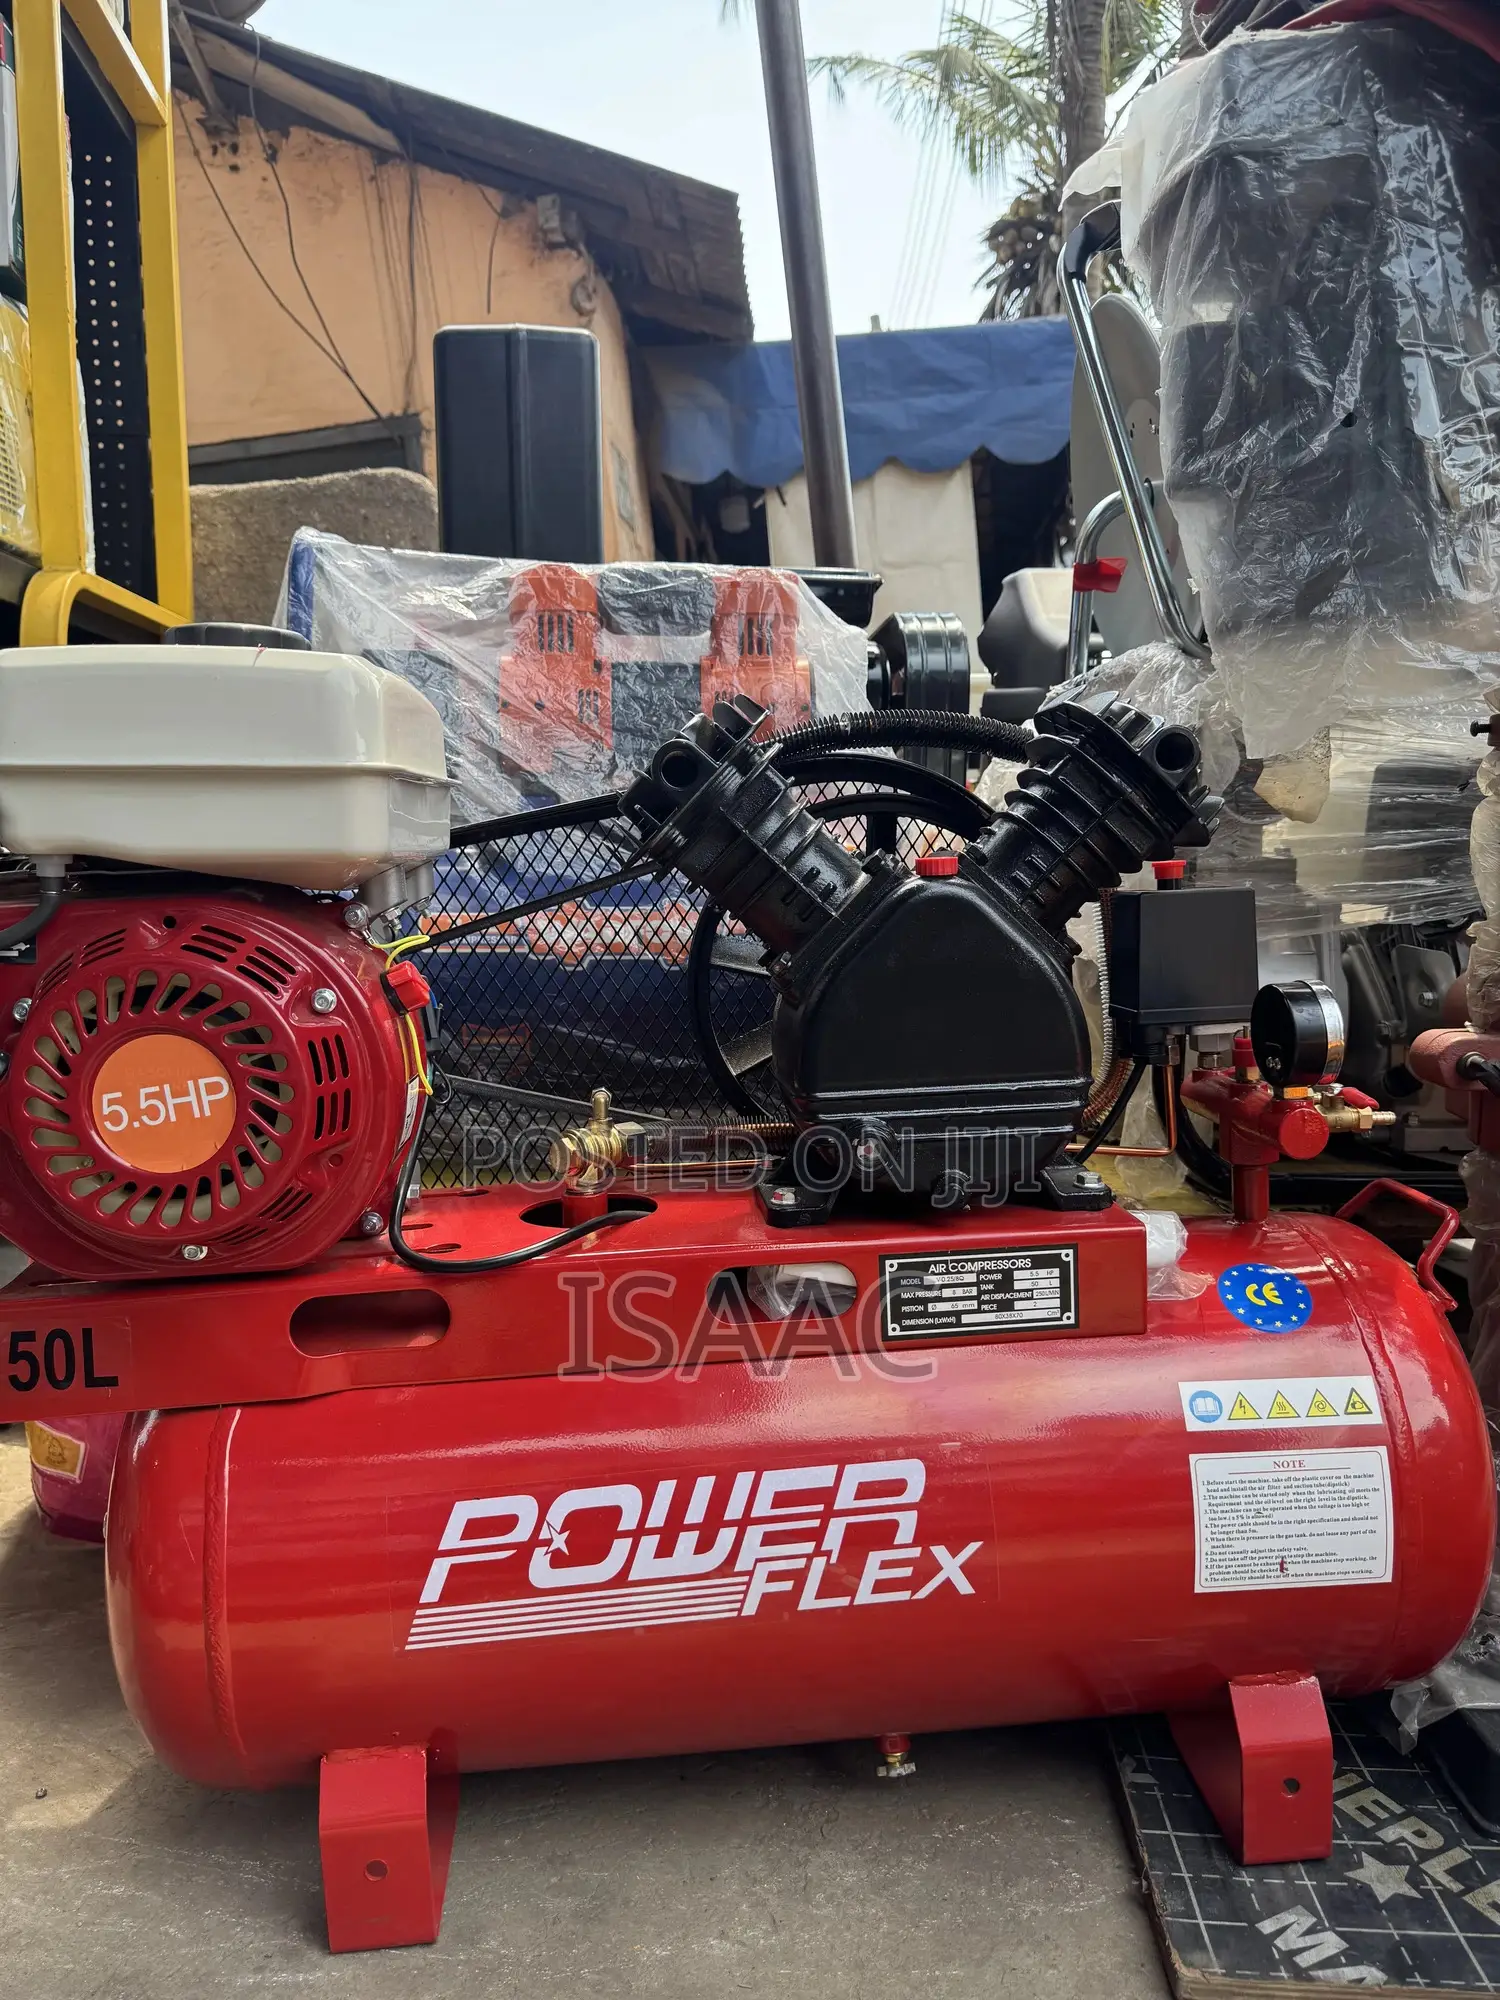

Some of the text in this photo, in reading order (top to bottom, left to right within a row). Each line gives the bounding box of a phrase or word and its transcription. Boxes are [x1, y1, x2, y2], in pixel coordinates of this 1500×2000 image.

[102, 1076, 230, 1132] 5.5HP
[928, 1259, 1032, 1273] AIR COMPRESSORS
[915, 1290, 942, 1298] PRESSURE
[991, 1292, 1032, 1300] DISPLACEMENT
[1245, 1281, 1284, 1307] CE
[902, 1318, 934, 1326] DIMENSION
[8, 1327, 120, 1392] 50L
[1273, 1460, 1306, 1469] NOTE
[418, 1458, 927, 1603] POWER
[740, 1541, 985, 1617] FLEX
